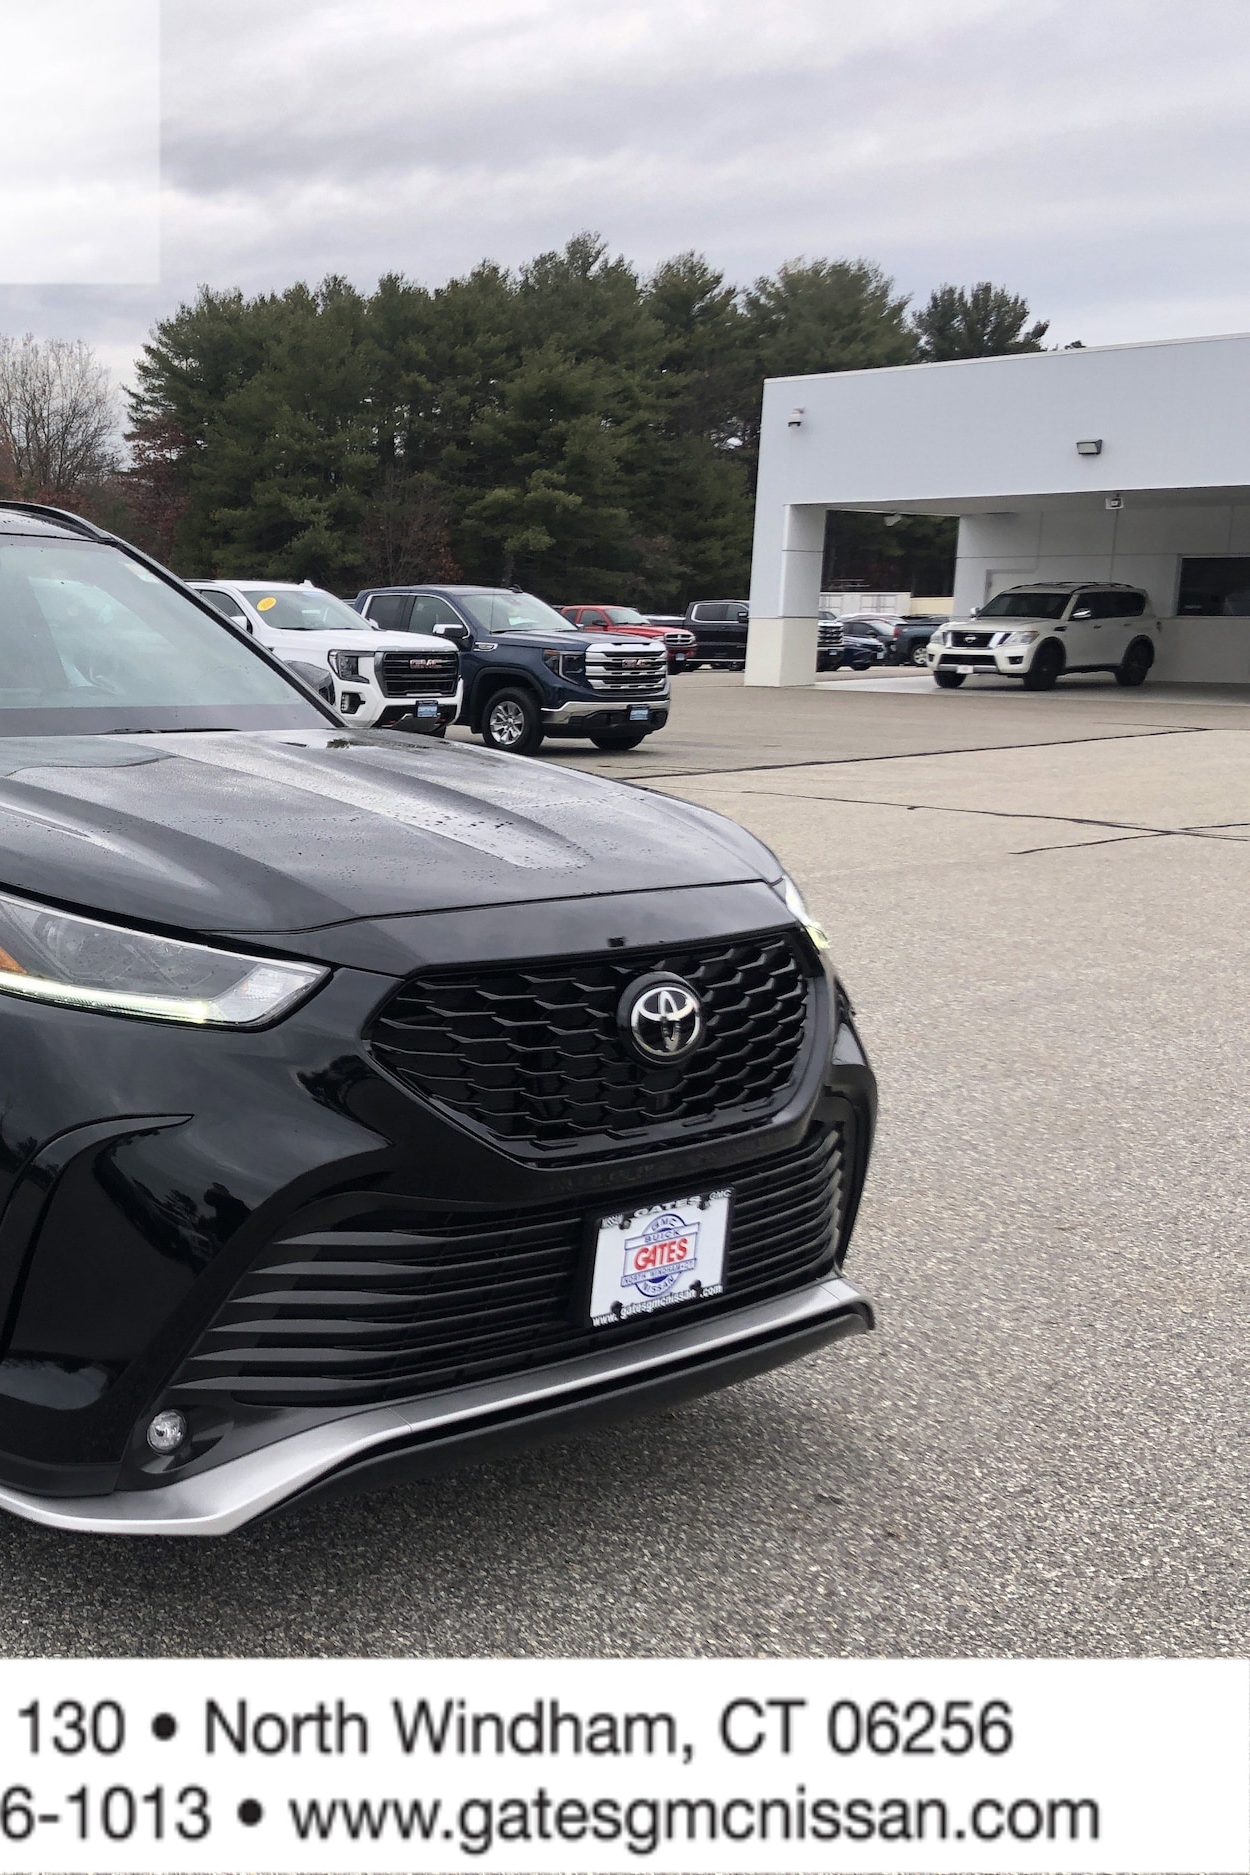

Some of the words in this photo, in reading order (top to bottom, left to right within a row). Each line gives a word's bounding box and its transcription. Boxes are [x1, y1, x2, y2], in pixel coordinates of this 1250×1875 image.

[633, 1195, 702, 1219] GATES
[709, 1189, 732, 1201] GMC
[644, 1229, 680, 1243] BUICK
[634, 1237, 688, 1271] GATES
[643, 1274, 674, 1293] NISSAN
